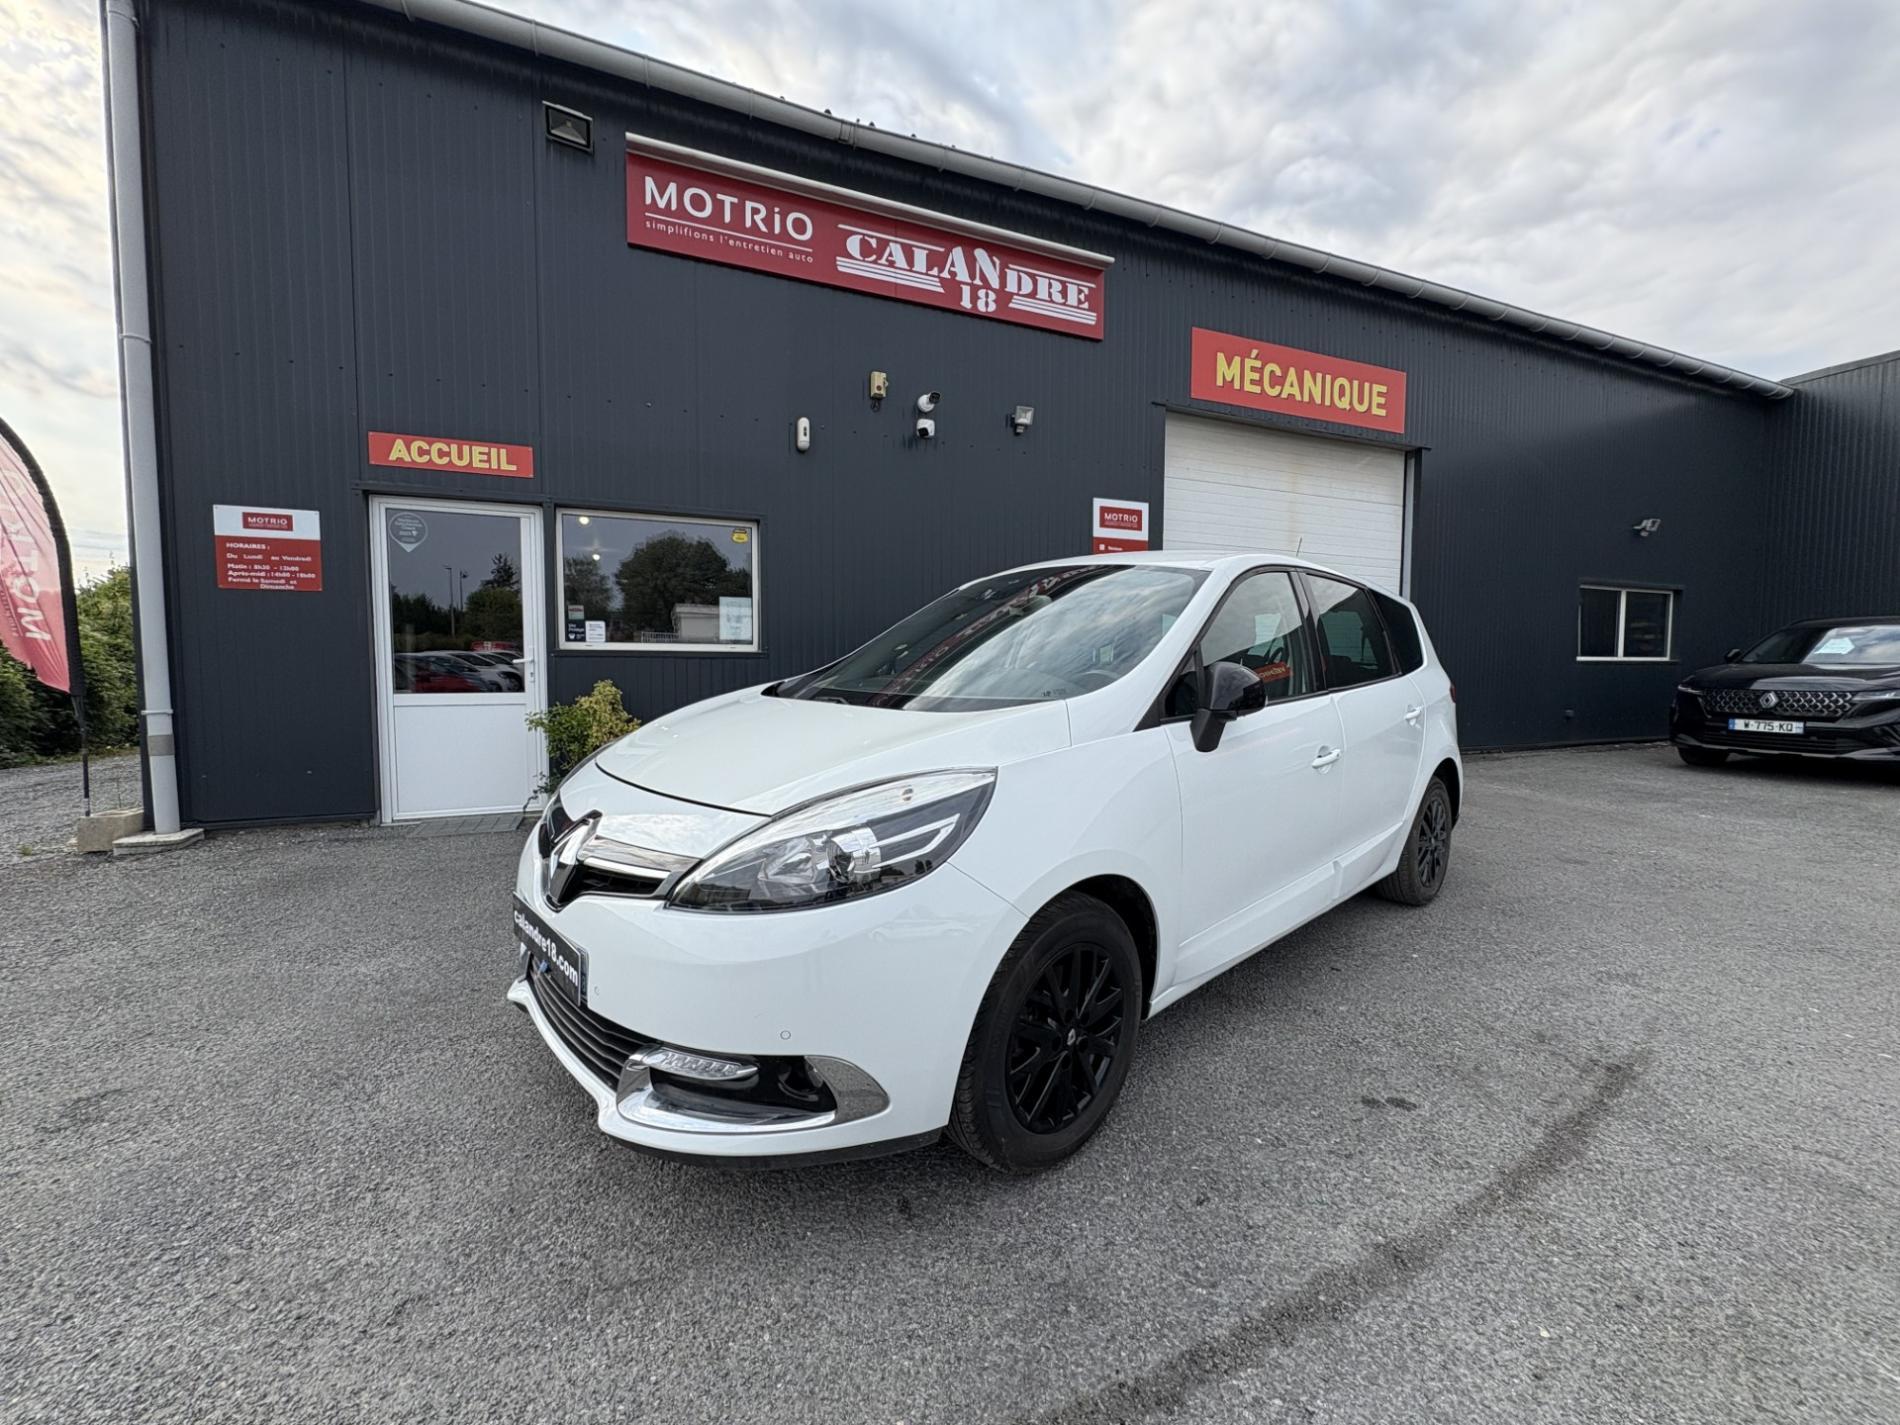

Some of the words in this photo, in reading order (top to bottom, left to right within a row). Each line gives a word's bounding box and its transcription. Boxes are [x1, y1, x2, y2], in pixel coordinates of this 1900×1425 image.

[645, 219, 715, 242] simplifions
[719, 233, 784, 257] l'entretien
[788, 251, 814, 264] auto
[846, 233, 1090, 310] CALANDRE
[959, 284, 997, 314] 18
[1215, 348, 1388, 418] MÉCANIQUE
[388, 438, 518, 472] ACCUEIL
